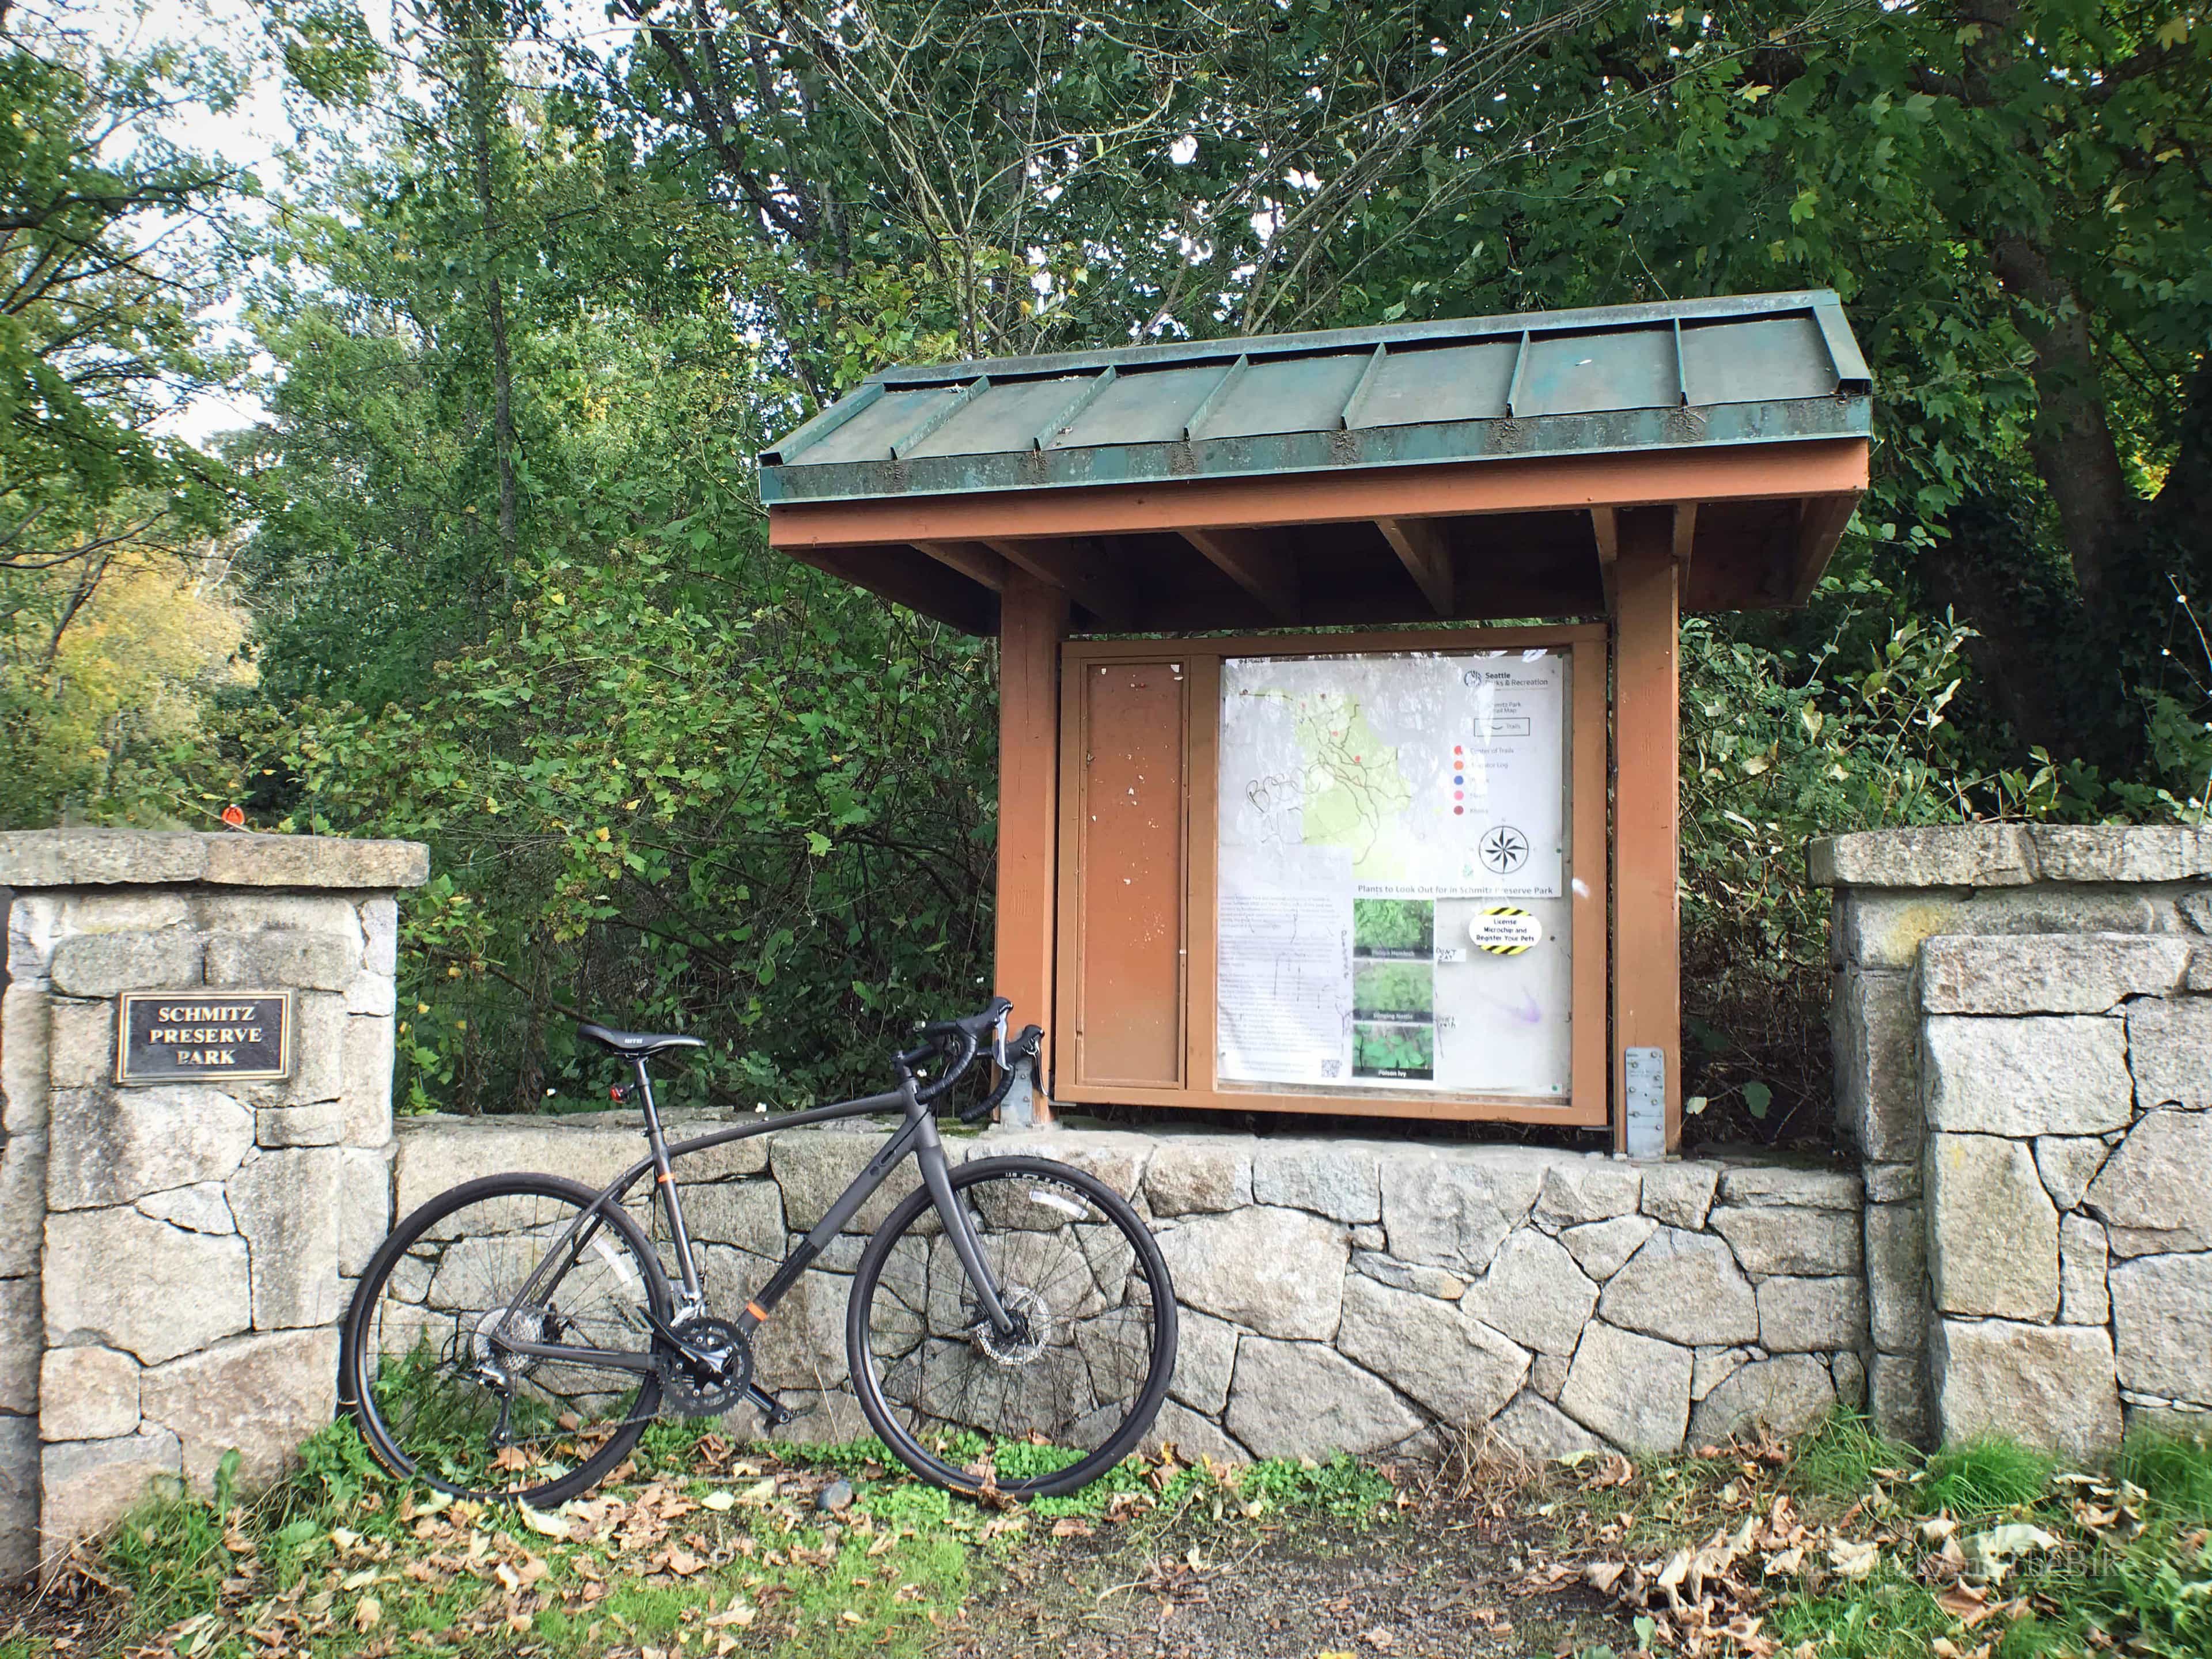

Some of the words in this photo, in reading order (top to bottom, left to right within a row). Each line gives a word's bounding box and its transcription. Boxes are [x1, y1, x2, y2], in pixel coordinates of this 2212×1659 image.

[1358, 885, 1384, 893] Plants
[1460, 887, 1492, 895] Schmitz
[158, 1006, 255, 1023] SCHMITZ
[149, 1027, 263, 1044] PRESERVE
[176, 1049, 236, 1066] PARK
